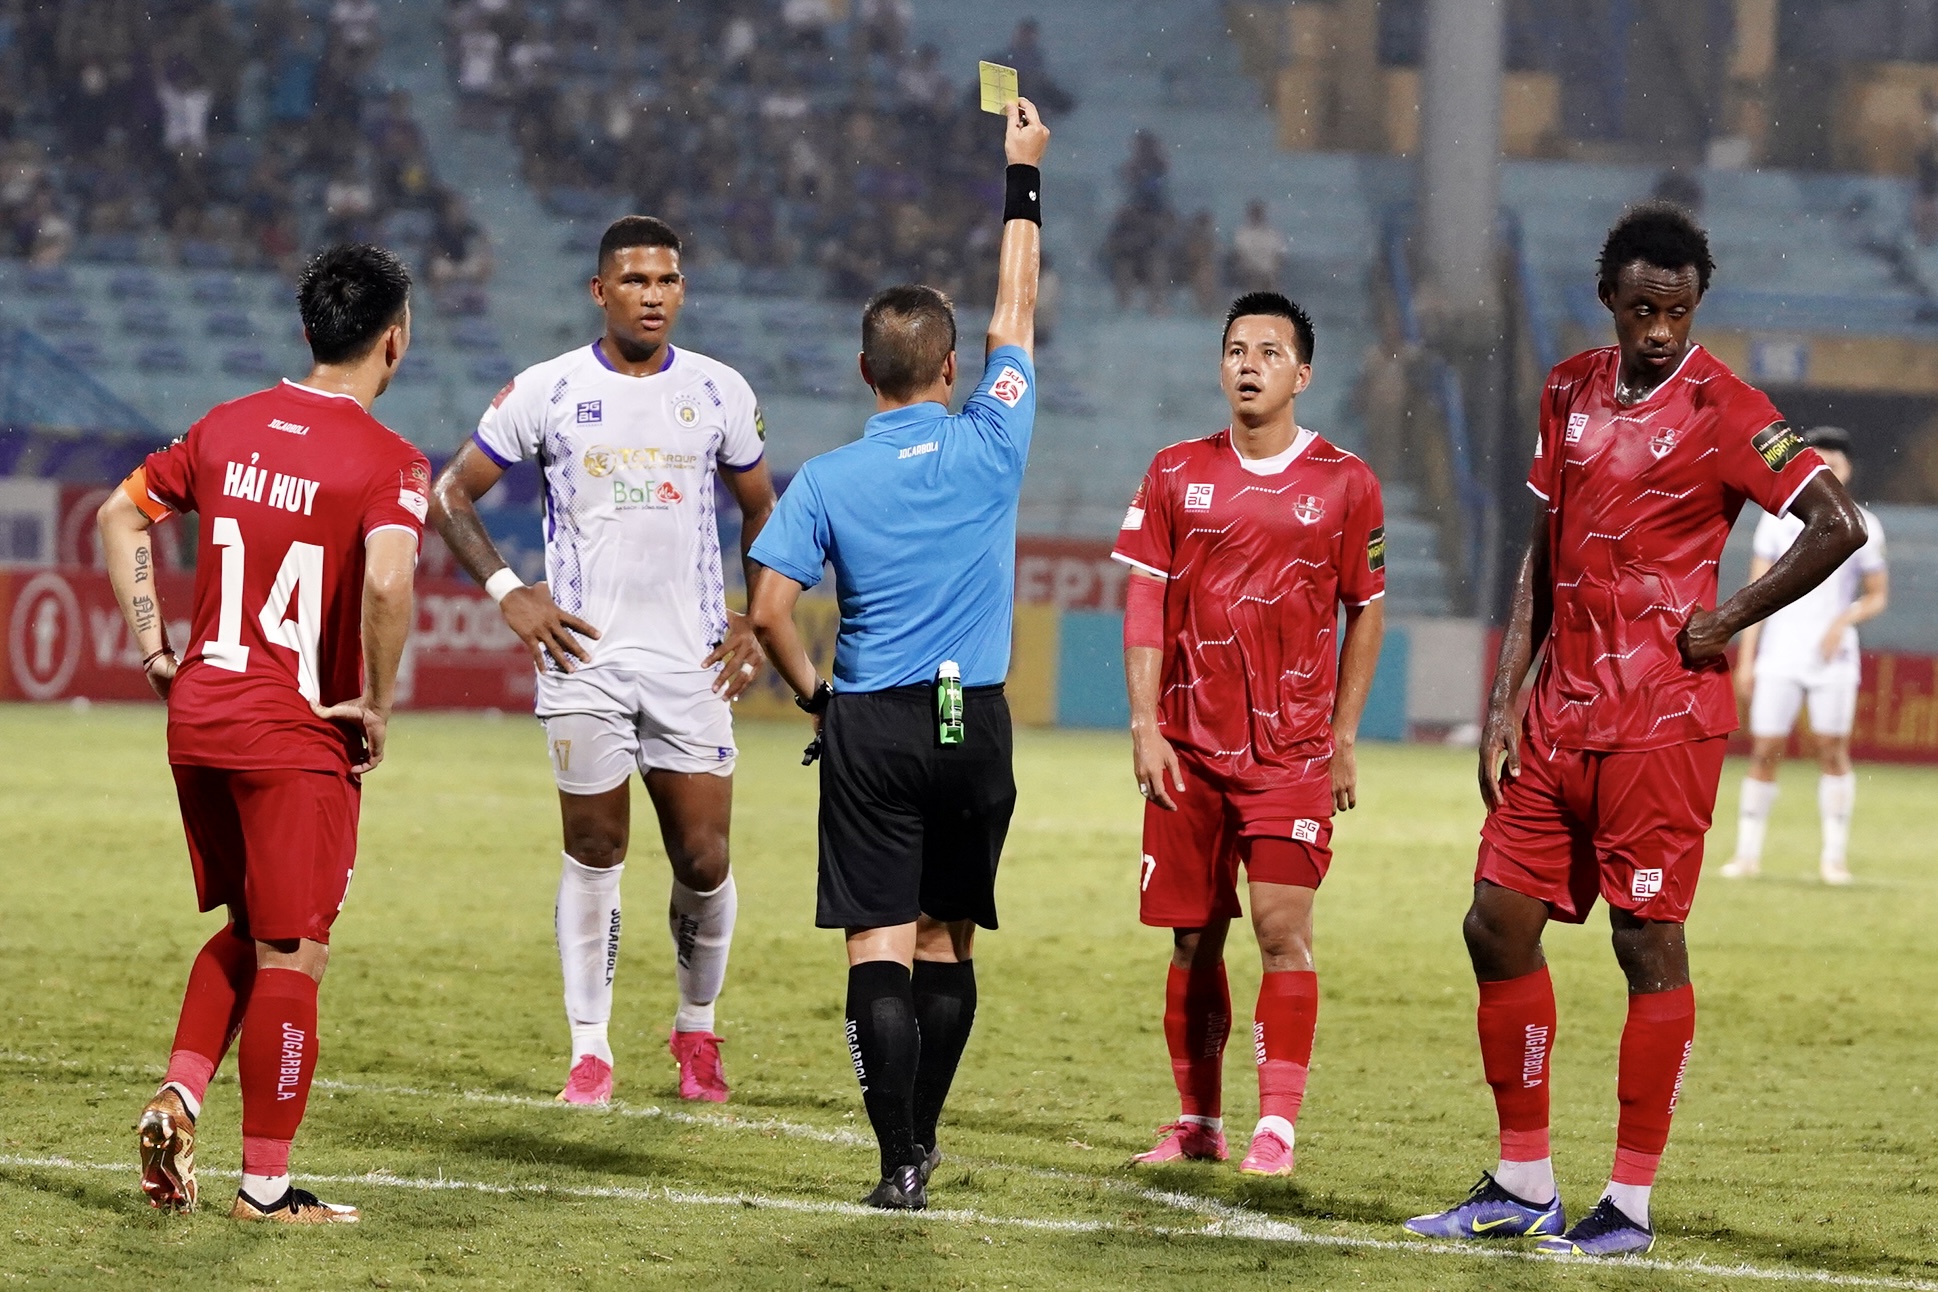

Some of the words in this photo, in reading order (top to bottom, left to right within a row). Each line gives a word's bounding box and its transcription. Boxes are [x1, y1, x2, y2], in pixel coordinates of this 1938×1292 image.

[1004, 370, 1024, 388] VPF
[267, 418, 310, 436] JOGARBOLA
[660, 454, 698, 463] GROUP
[897, 441, 939, 460] JOGARBOLA
[1763, 436, 1791, 464] NIGHT
[223, 452, 268, 503] HẢI
[268, 473, 320, 516] HUY
[613, 480, 656, 503] BaF
[134, 546, 151, 583] Gia
[203, 517, 325, 703] 14
[554, 739, 572, 771] 17
[605, 908, 621, 987] JOGARBOLA
[277, 1021, 305, 1101] JOGARBOLA
[1522, 1023, 1549, 1089] JOGARBOLA
